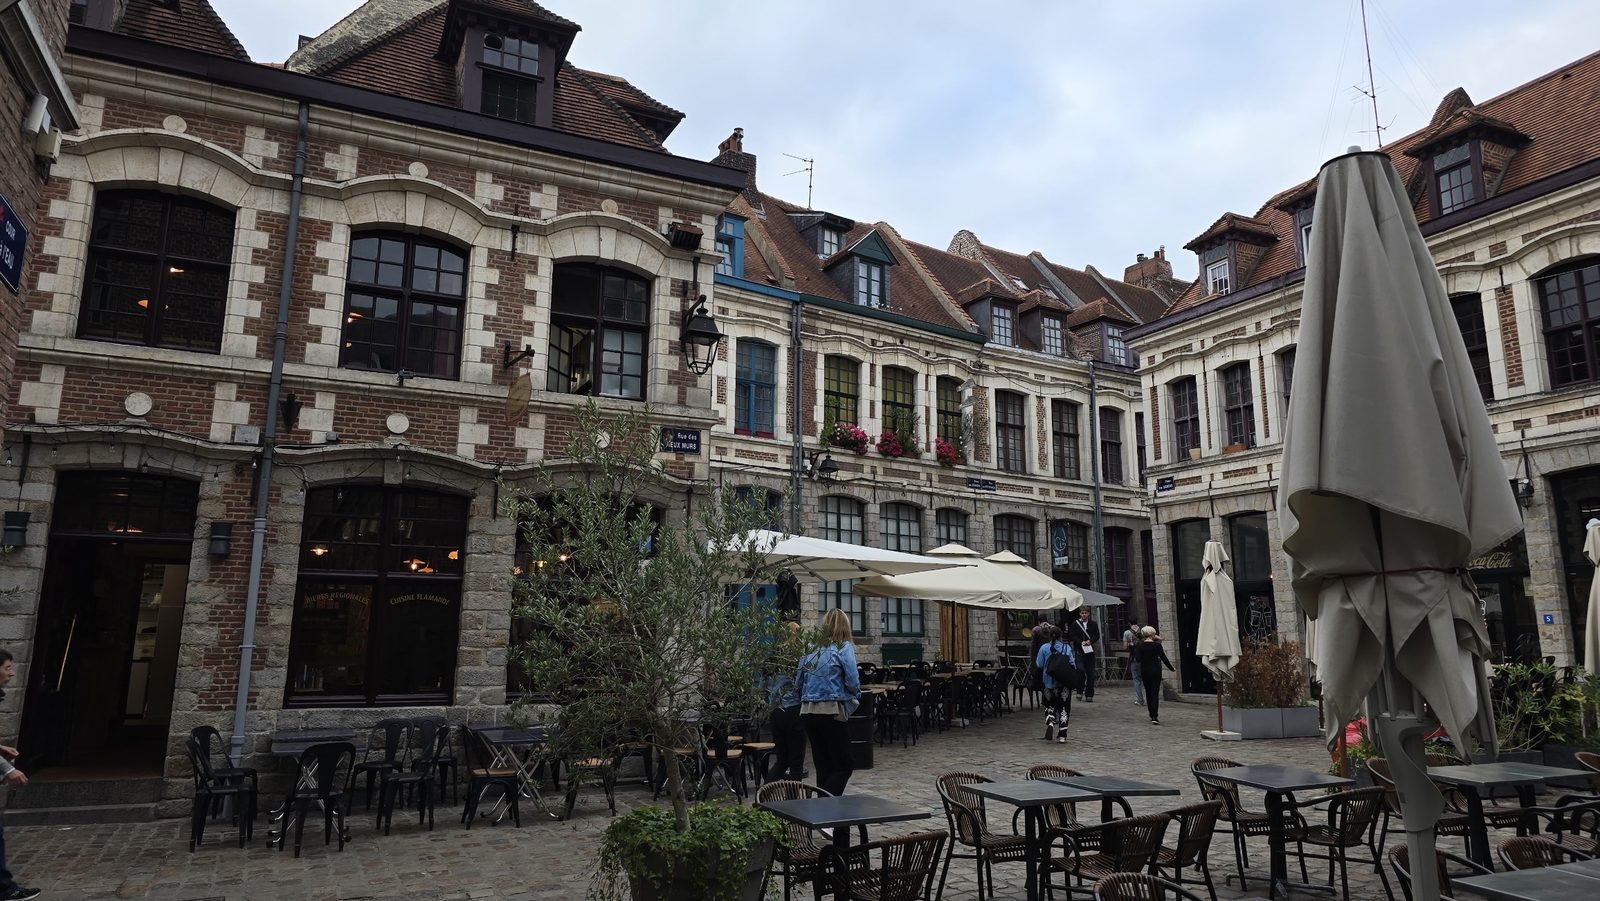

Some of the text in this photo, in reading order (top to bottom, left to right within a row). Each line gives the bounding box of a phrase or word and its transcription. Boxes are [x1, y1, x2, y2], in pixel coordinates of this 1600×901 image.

[677, 432, 697, 441] Rue des
[681, 442, 697, 450] MURS
